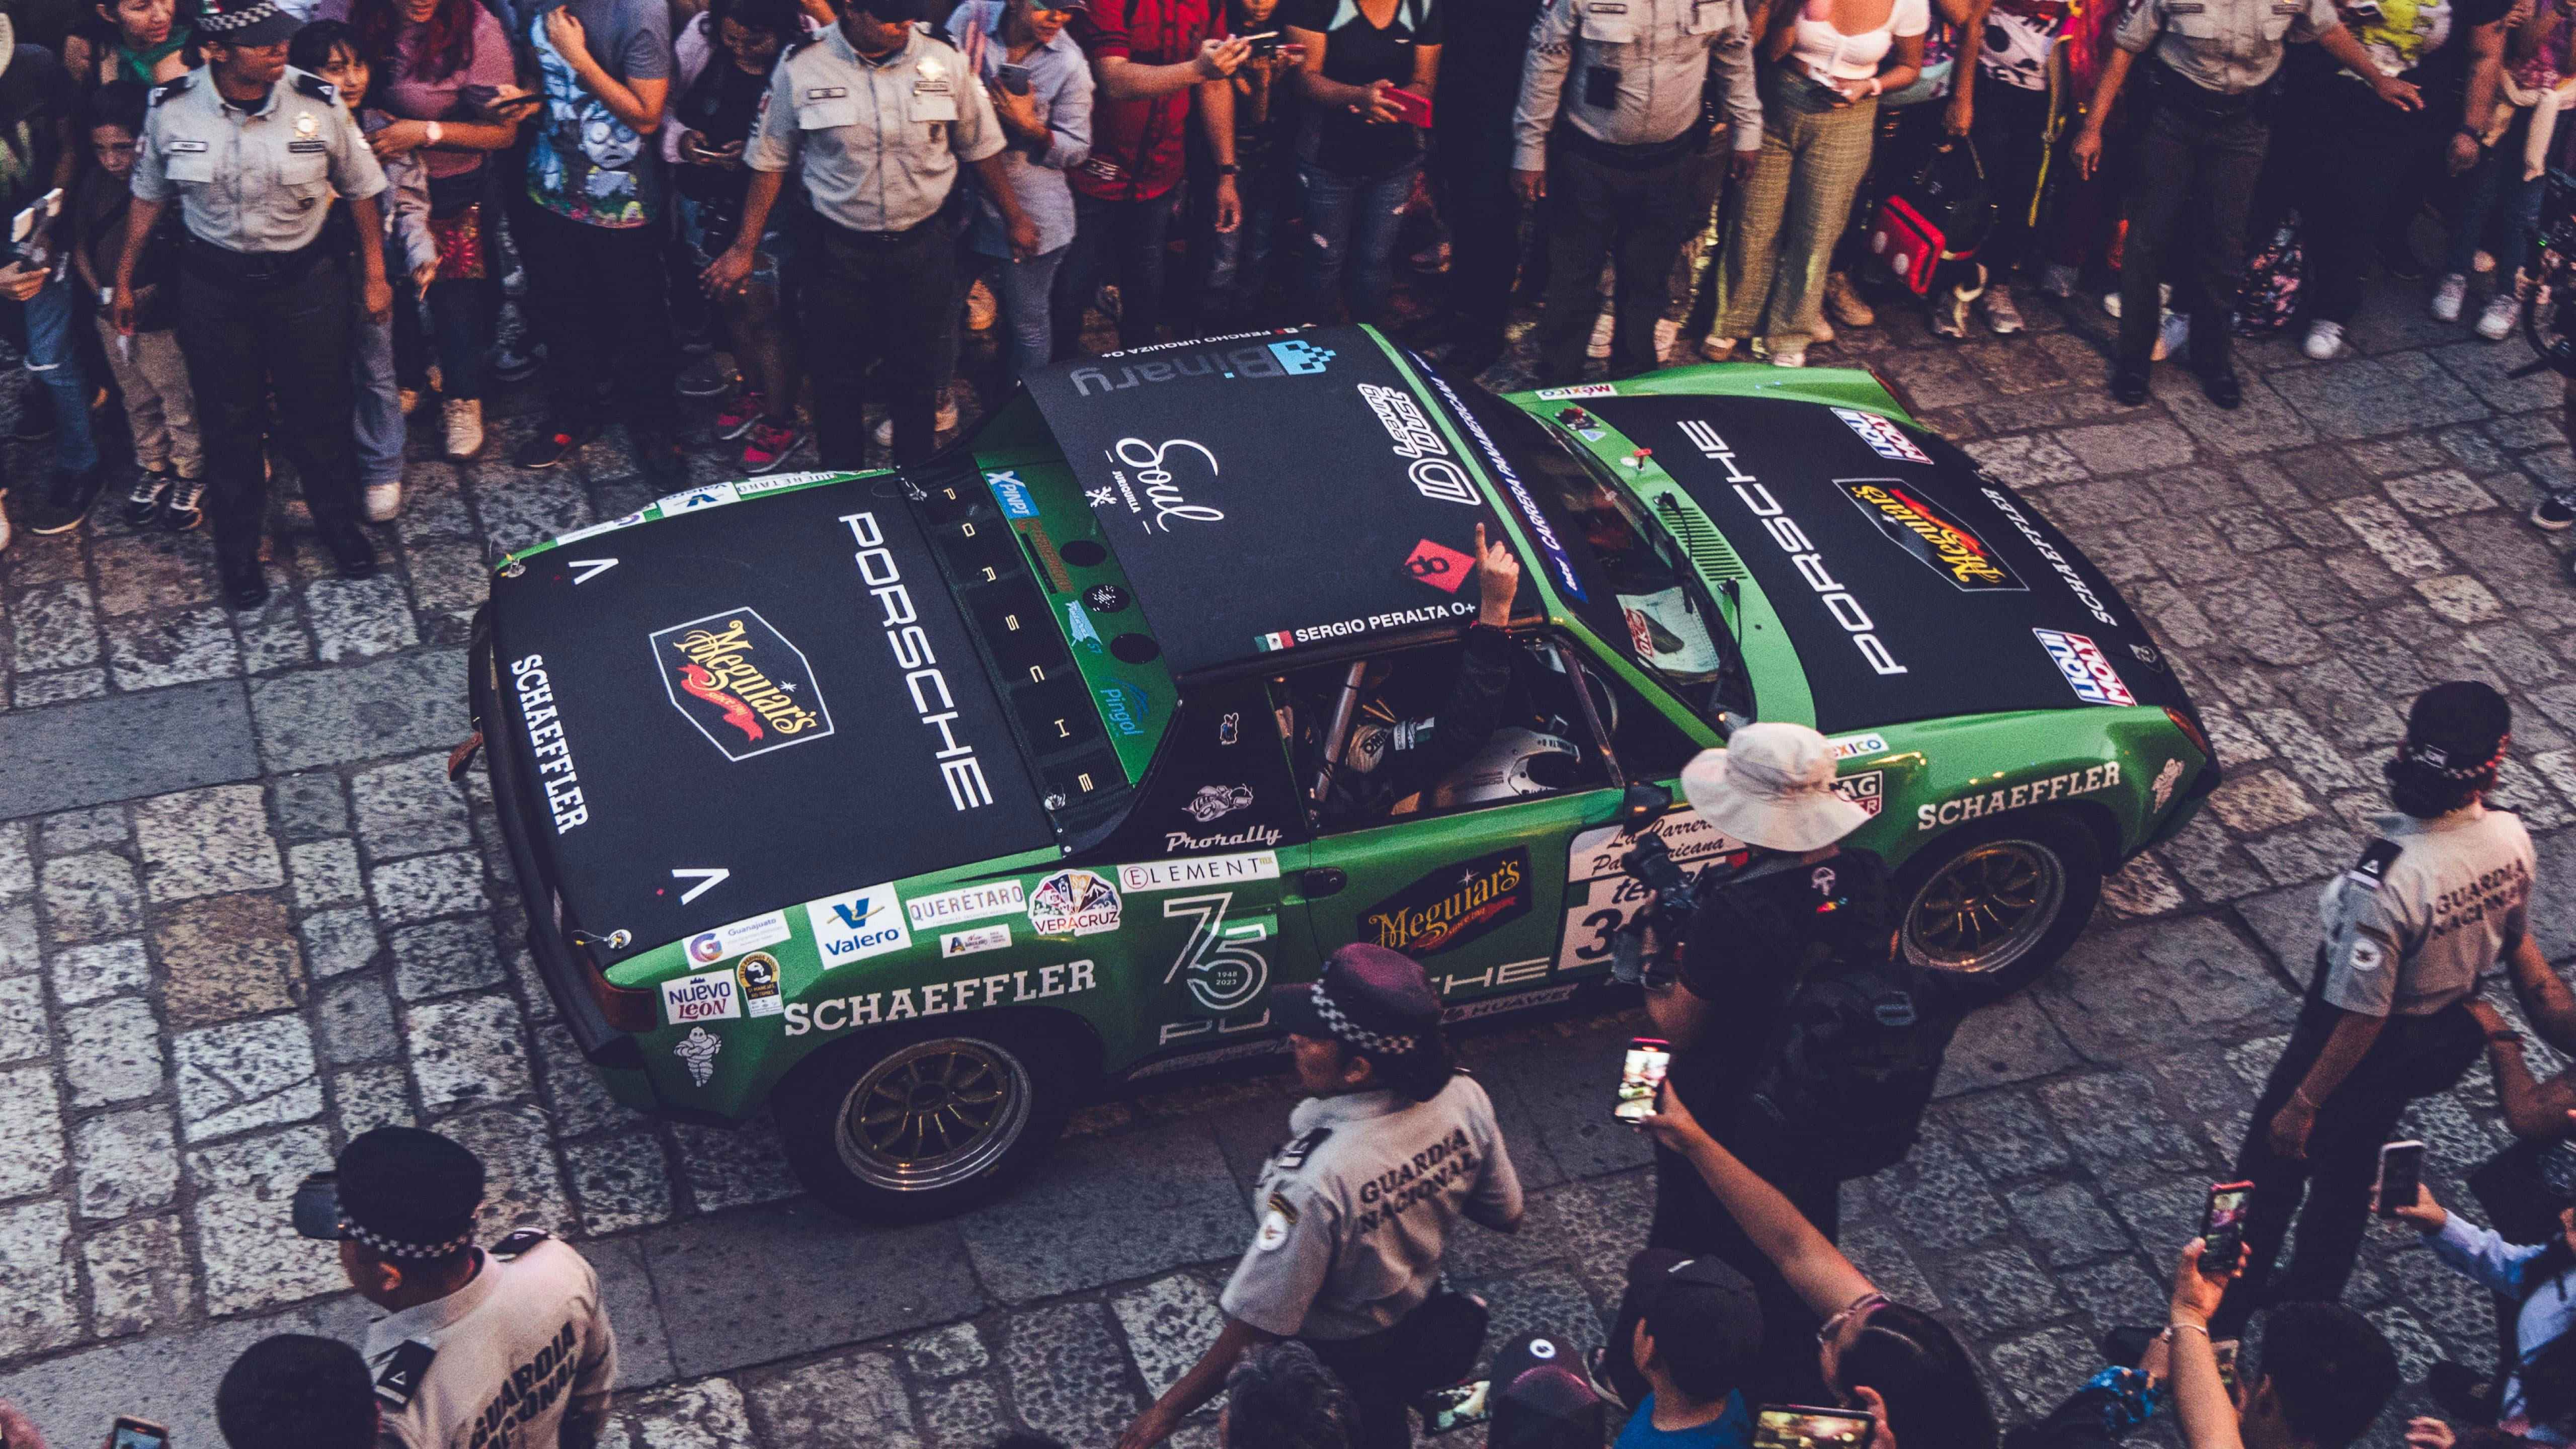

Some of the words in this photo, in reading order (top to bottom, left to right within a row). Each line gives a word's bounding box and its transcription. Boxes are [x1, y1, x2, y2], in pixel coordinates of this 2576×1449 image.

[1070, 344, 1286, 396] Binary
[1127, 339, 1201, 354] URQUIZA
[1204, 330, 1271, 343] FERCHO
[1431, 377, 1516, 483] PANAMERICANA
[1115, 438, 1224, 532] Soul
[1504, 478, 1561, 551] CARRERA
[1677, 421, 1907, 675] PORSCHE
[1850, 485, 2006, 584] Meguiar's
[1981, 488, 2117, 626] SCHAEFFLER
[1295, 618, 1365, 644] SERGIO
[1369, 606, 1450, 630] PERALTA
[673, 620, 817, 734] Meguiar's
[839, 512, 993, 811] PORSCHE
[2038, 631, 2104, 700] LIQUI
[2065, 634, 2132, 704] MOLY
[512, 654, 589, 834] SCHAEFFLER
[1833, 740, 1881, 757] XICO
[1837, 776, 1876, 797] AG
[1918, 762, 2120, 831] SCHAEFFLER
[1165, 825, 1282, 852] Prorally
[1650, 819, 1712, 837] Carrer
[728, 918, 776, 936] Guanajuato
[910, 886, 1023, 921] QUERÉTARO
[1035, 912, 1118, 932] VERACRUZ
[1369, 859, 1520, 948] Meguiar's
[825, 928, 899, 955] Valero
[1164, 892, 1267, 1010] 75
[784, 959, 1096, 1036] SCHAEFFLER
[1360, 1128, 1470, 1204] GUARDIA
[1361, 1153, 1478, 1231] NACIONAL
